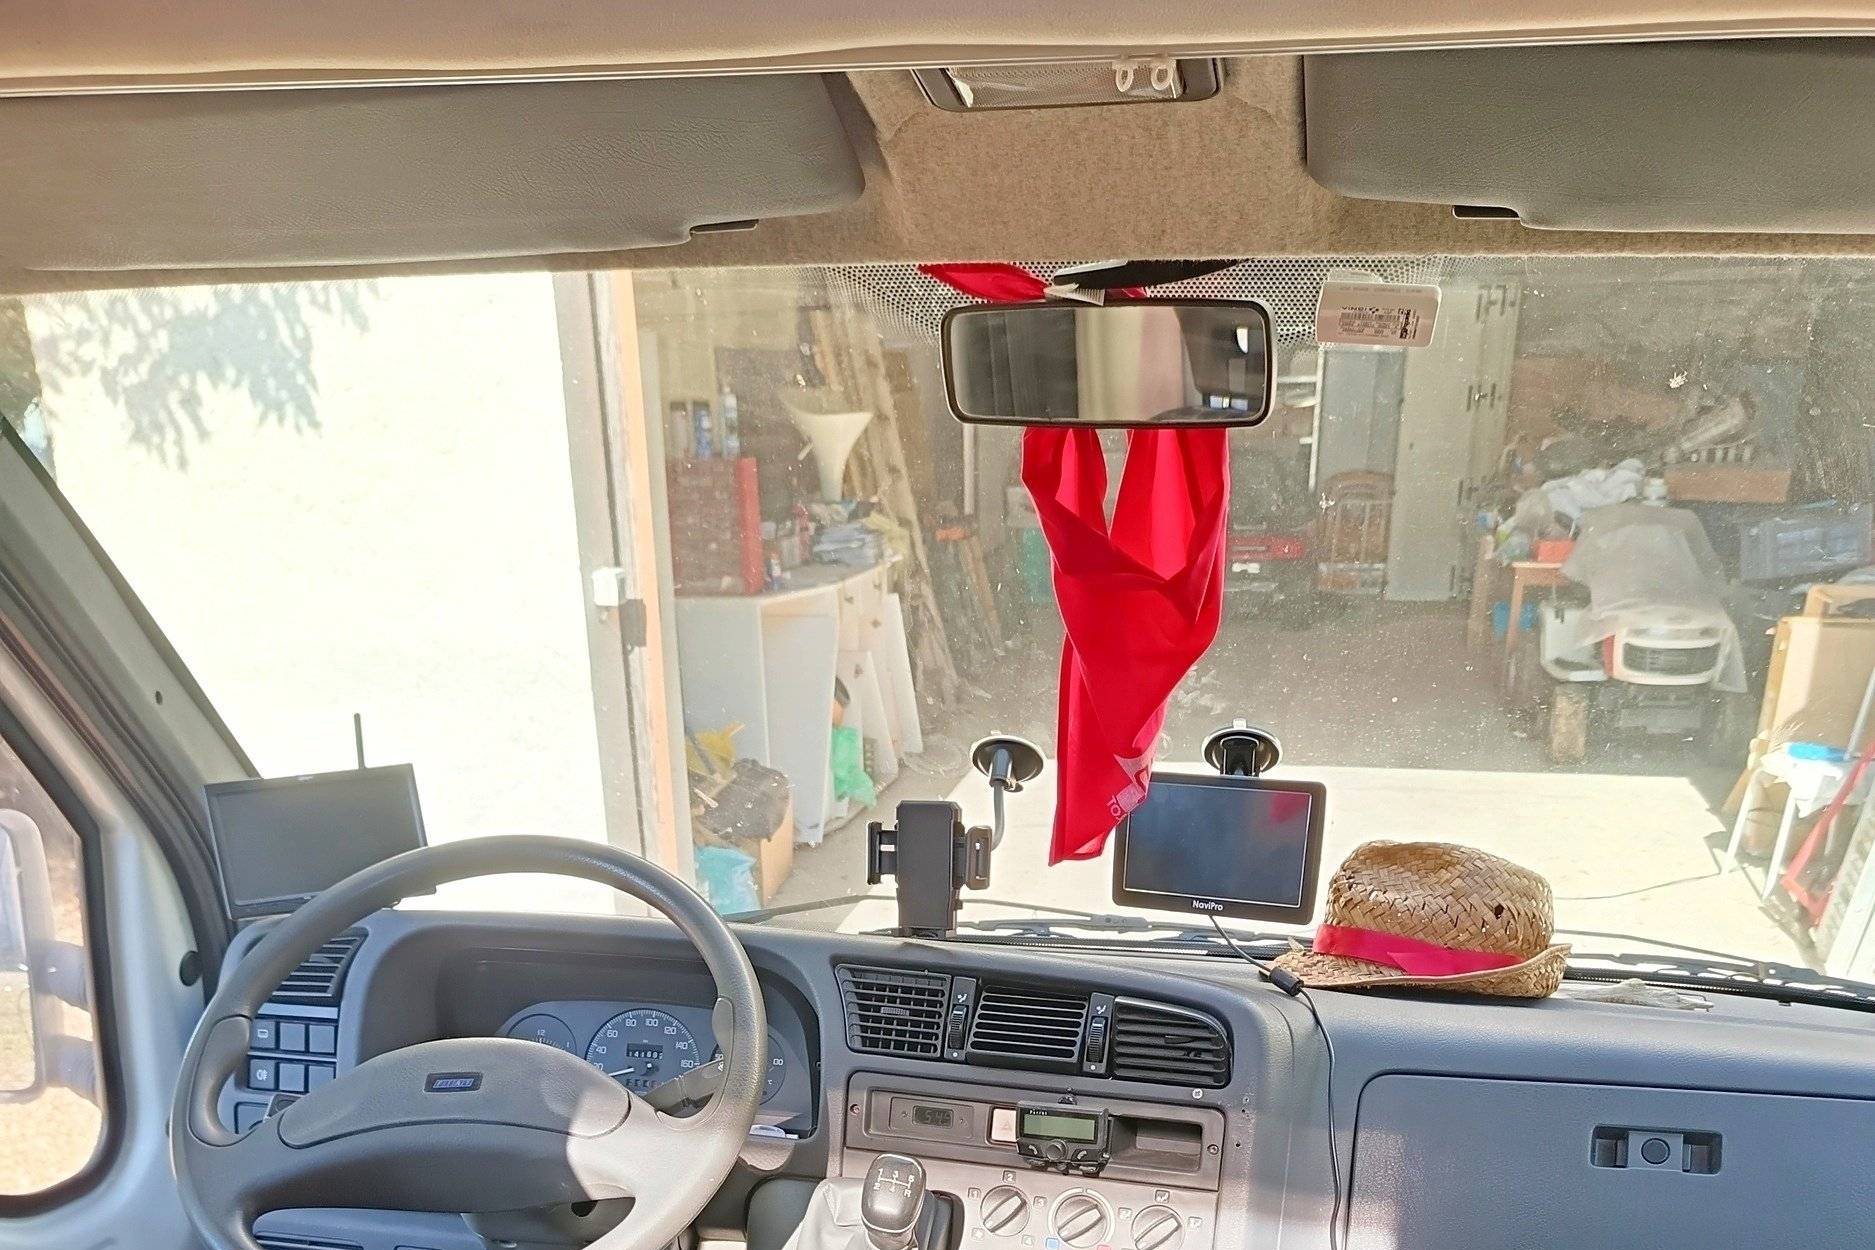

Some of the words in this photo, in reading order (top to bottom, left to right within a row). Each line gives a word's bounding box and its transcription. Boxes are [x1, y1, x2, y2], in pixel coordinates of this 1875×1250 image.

[1192, 900, 1224, 911] NaviPro
[626, 1019, 636, 1027] 80
[645, 1019, 658, 1027] 100
[607, 1030, 618, 1038] 60
[664, 1027, 676, 1035] 120
[596, 1046, 607, 1054] 40
[675, 1042, 688, 1050] 140
[680, 1060, 694, 1068] 160
